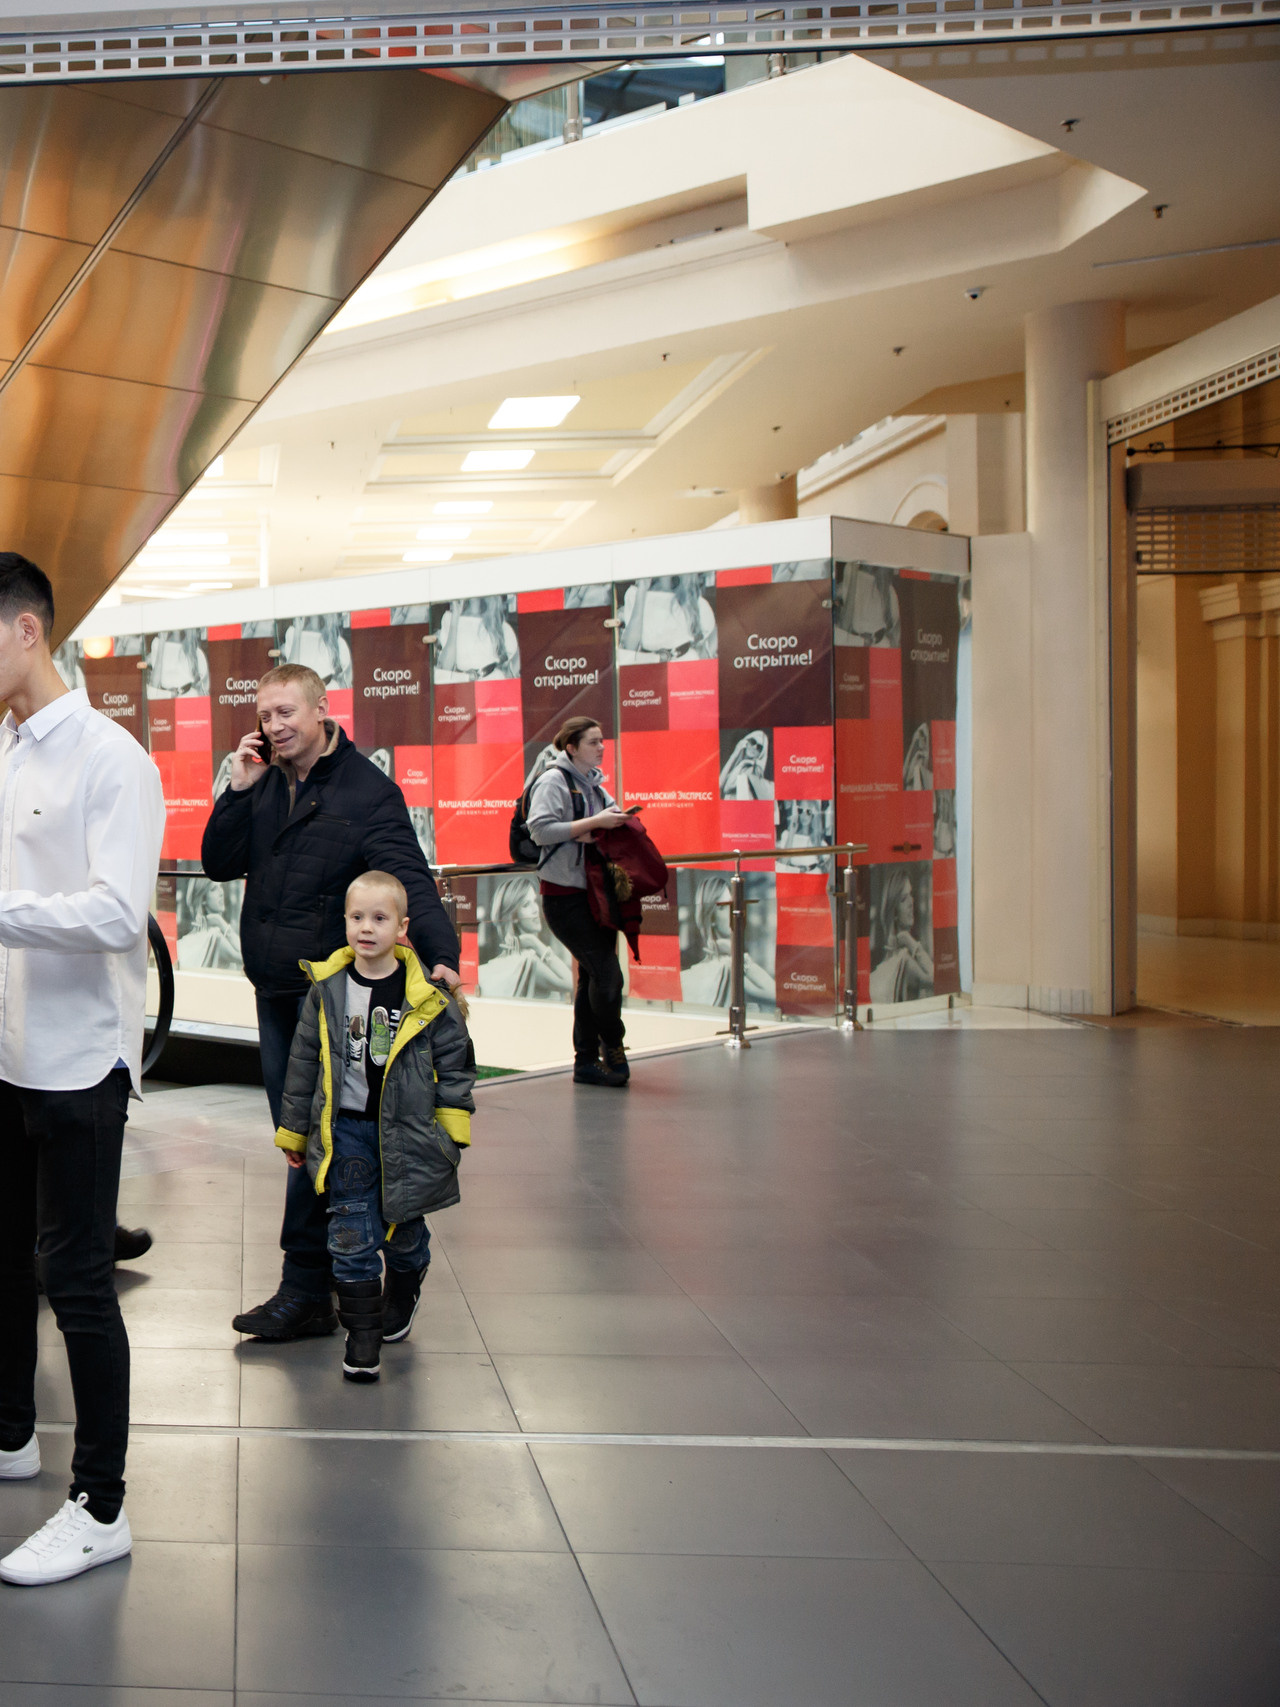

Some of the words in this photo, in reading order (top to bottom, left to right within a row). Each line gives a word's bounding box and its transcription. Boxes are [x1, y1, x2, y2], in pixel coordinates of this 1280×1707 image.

[747, 634, 798, 653] Скоро
[545, 655, 587, 673] Скоро
[733, 649, 813, 671] открытие!
[373, 667, 412, 684] Скоро
[533, 669, 599, 690] открытие!
[225, 677, 259, 692] Скоро
[363, 680, 420, 700] открытие!
[102, 693, 129, 706] Скоро
[628, 689, 655, 700] Скоро
[789, 755, 817, 766] Скоро
[790, 972, 818, 982] Скоро
